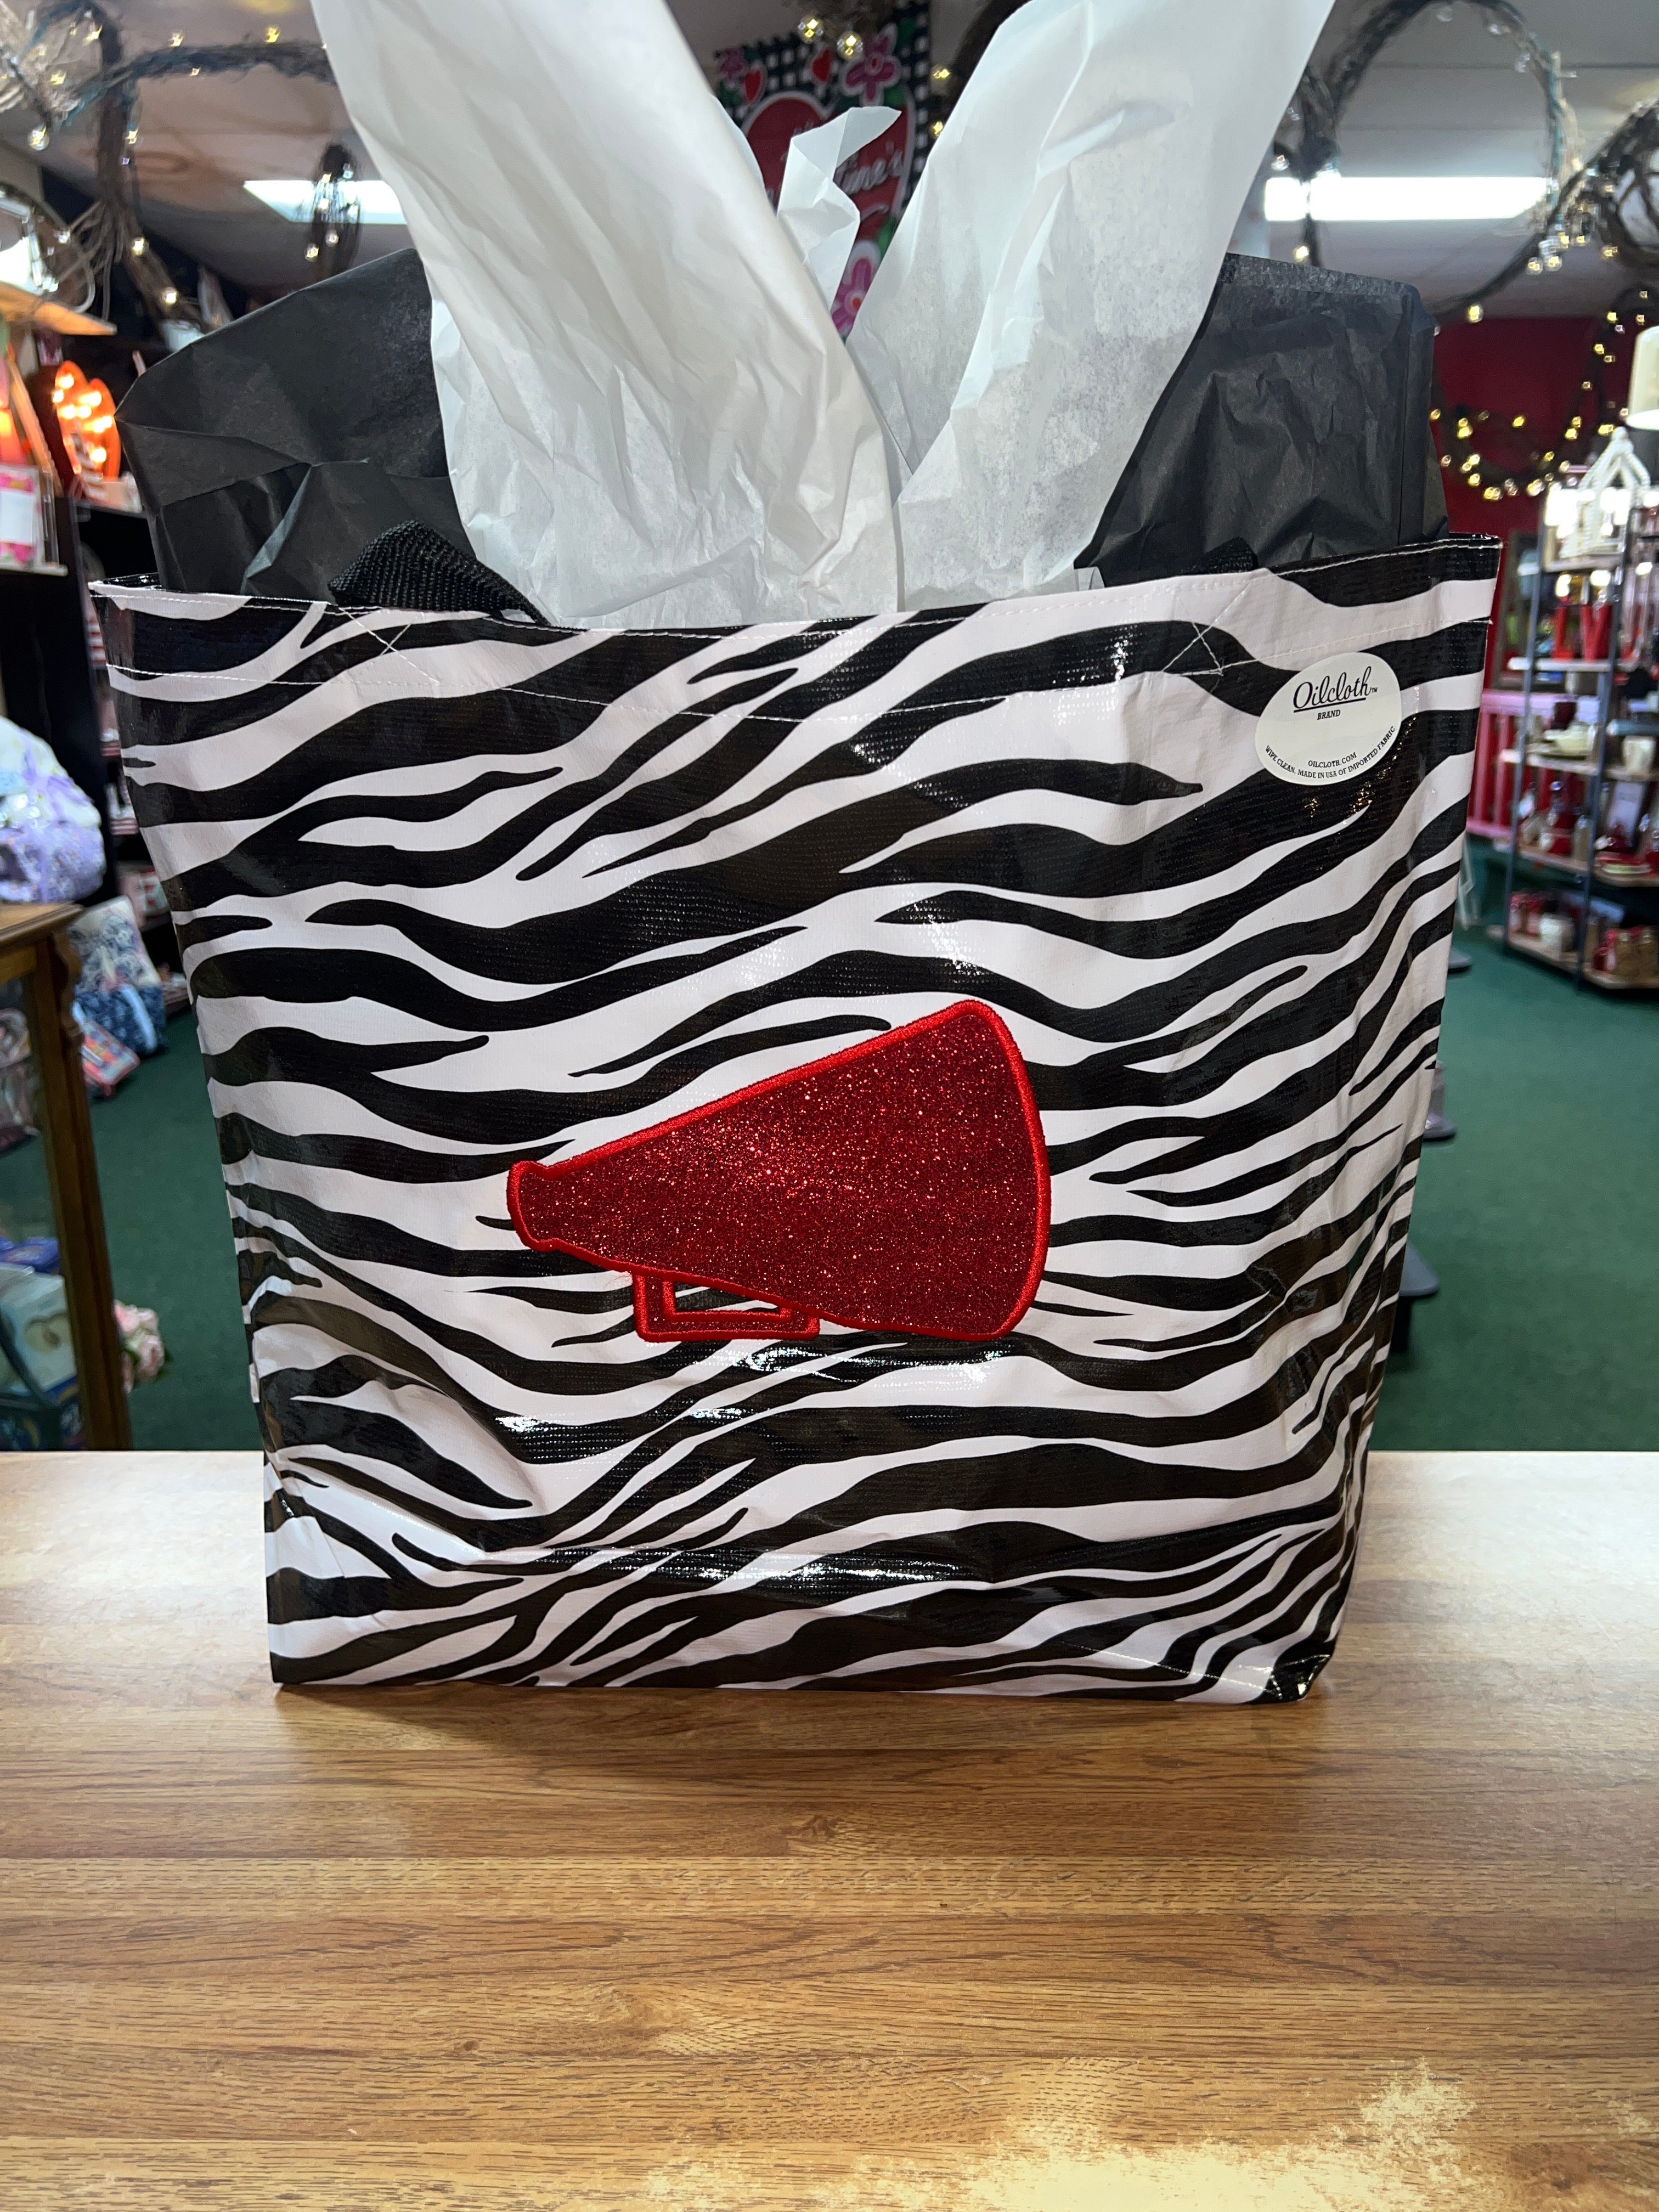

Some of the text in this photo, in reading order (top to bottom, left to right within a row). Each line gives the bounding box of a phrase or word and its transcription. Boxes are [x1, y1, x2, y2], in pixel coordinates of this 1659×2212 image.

[1317, 709, 1341, 720] BRAND
[1265, 744, 1278, 761] WIPE
[1277, 758, 1296, 774] CLEAN.
[1297, 769, 1317, 778] MADE
[1338, 768, 1347, 776] OF
[1347, 748, 1378, 772] IMPORTED
[1377, 725, 1395, 751] FABRIC
[1308, 752, 1357, 768] OILCLOTH.COM
